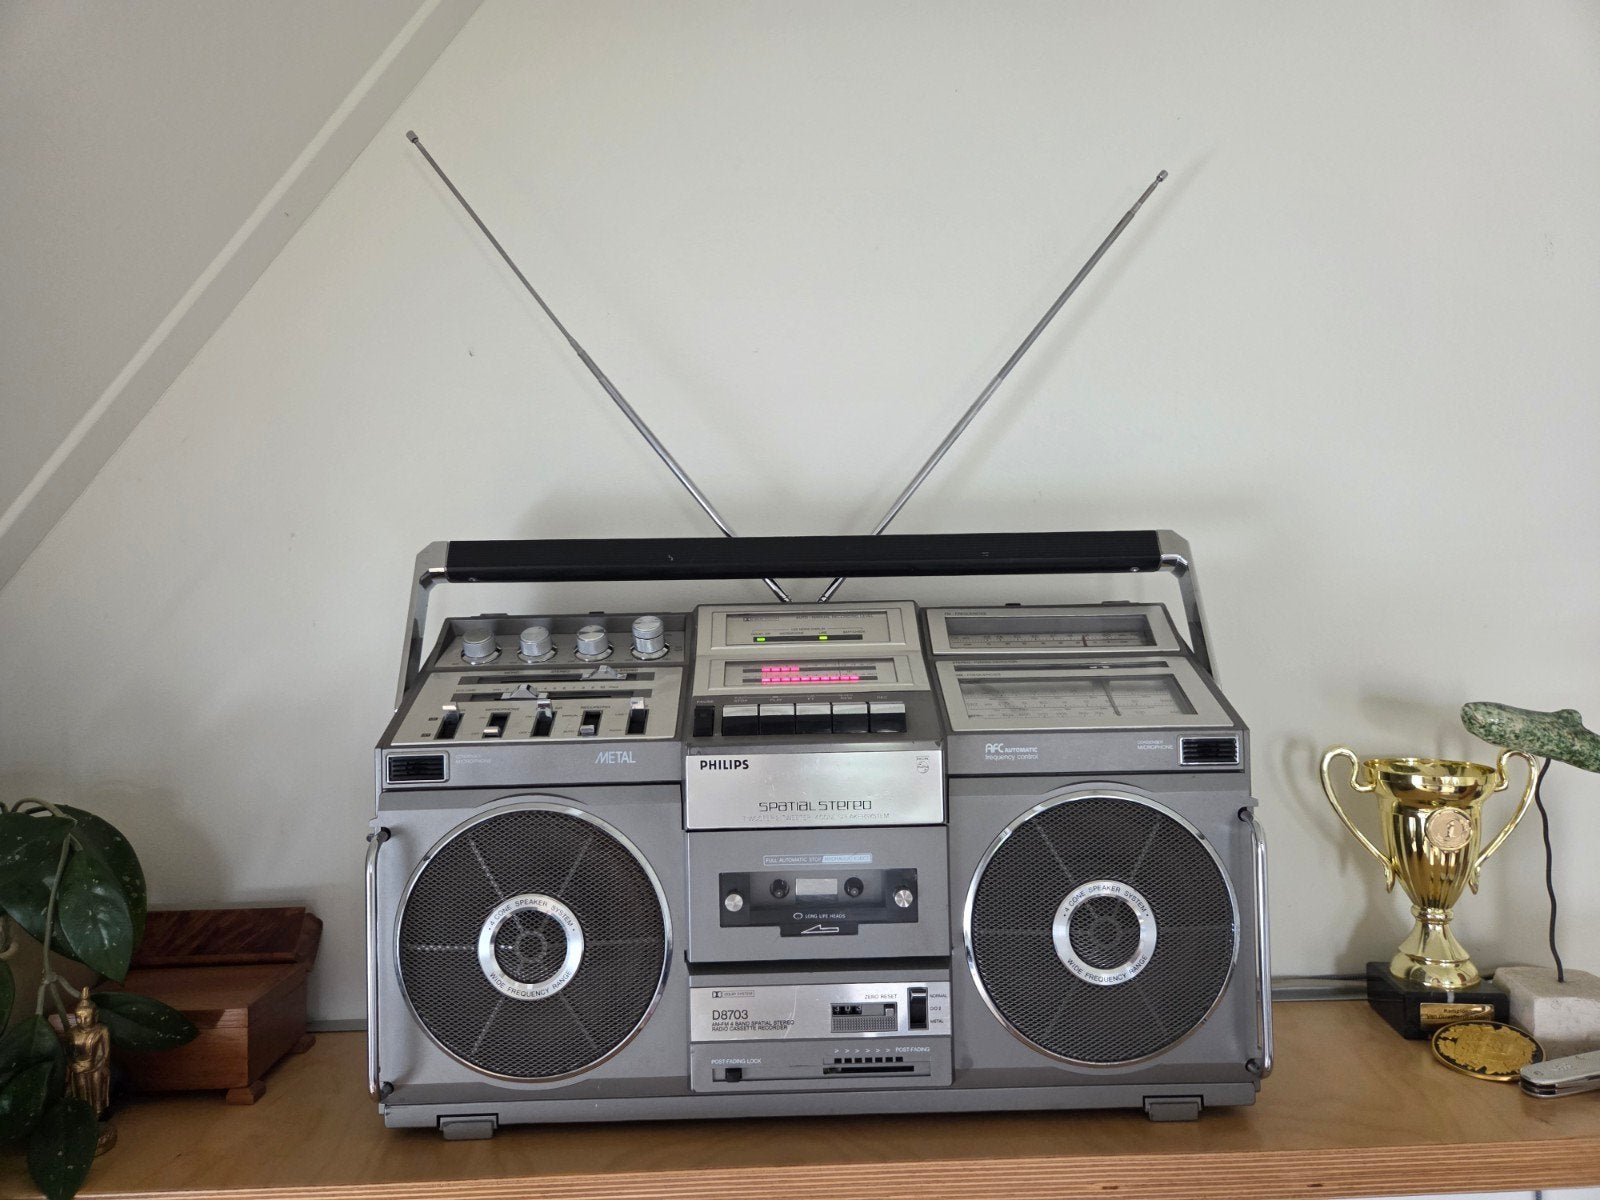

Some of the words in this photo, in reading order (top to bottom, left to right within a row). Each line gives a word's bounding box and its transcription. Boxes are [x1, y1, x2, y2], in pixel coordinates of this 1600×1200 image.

[595, 750, 637, 764] METAL
[985, 742, 1004, 753] AFC
[699, 759, 750, 771] PHILIPS
[1068, 890, 1086, 907] CONE
[1088, 885, 1121, 894] SPEAKER
[1123, 890, 1147, 913] SYSTEM
[494, 904, 512, 921] CONE
[514, 899, 548, 907] SPEAKER
[550, 904, 574, 927] SYSTEM
[1067, 958, 1084, 975] WIDE
[1084, 972, 1128, 983] FREQUENCY
[1128, 955, 1148, 974] RANGE
[489, 971, 506, 989] WIDE
[507, 986, 550, 997] FREQUENCY
[552, 970, 572, 990] RANGE
[712, 1009, 749, 1021] D8703
